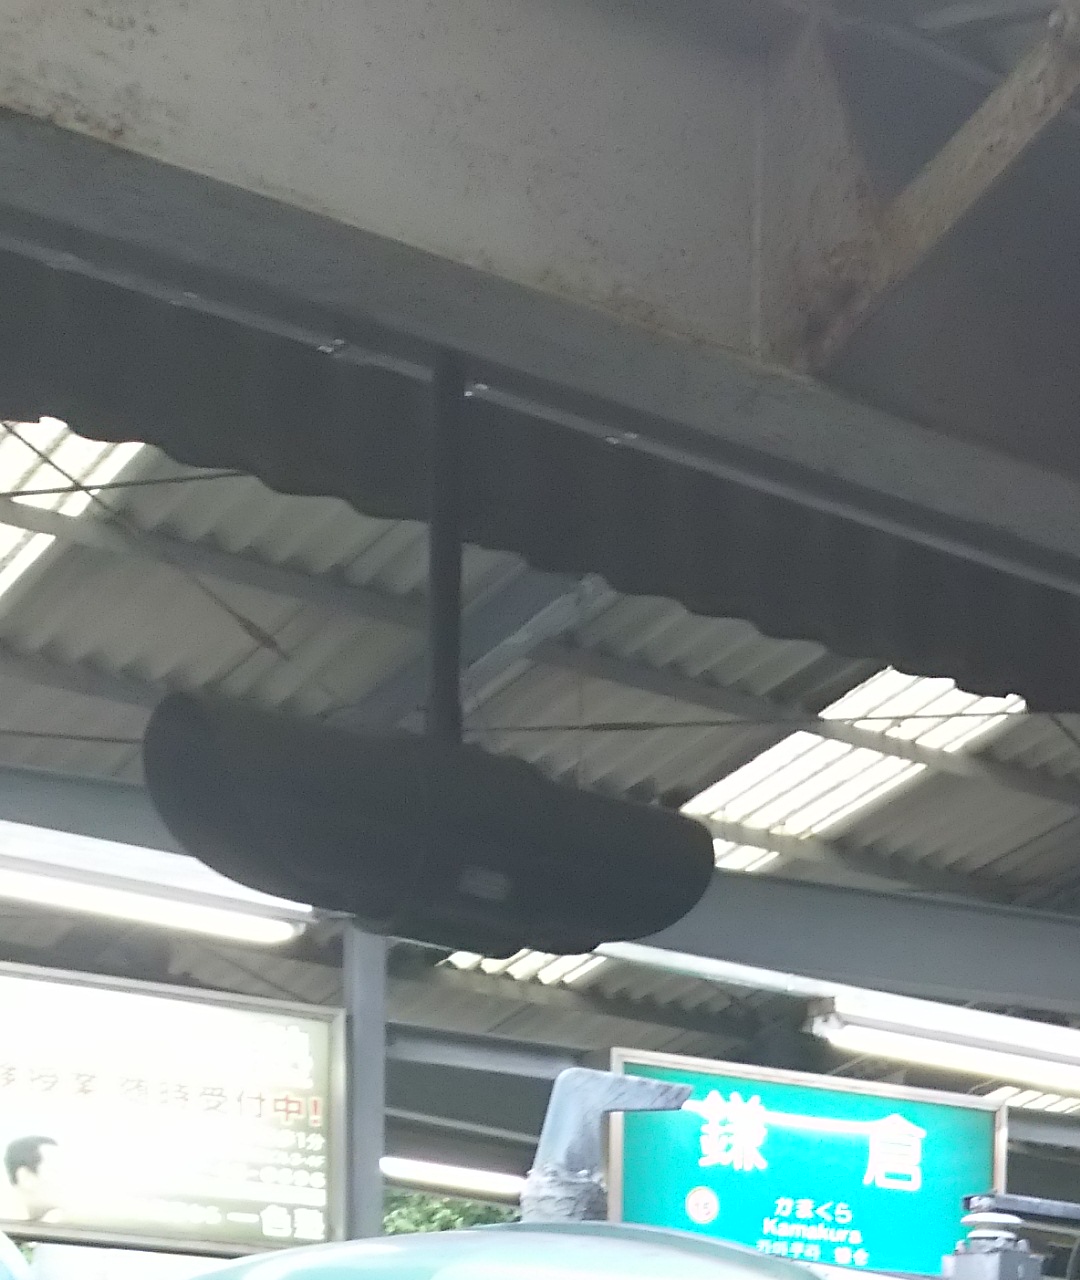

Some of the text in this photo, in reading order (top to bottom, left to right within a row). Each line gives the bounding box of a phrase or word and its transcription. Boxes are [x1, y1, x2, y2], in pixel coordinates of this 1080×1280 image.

[698, 1088, 928, 1193] 鎌倉
[773, 1196, 853, 1225] かまくら
[761, 1216, 863, 1246] Kamakura
